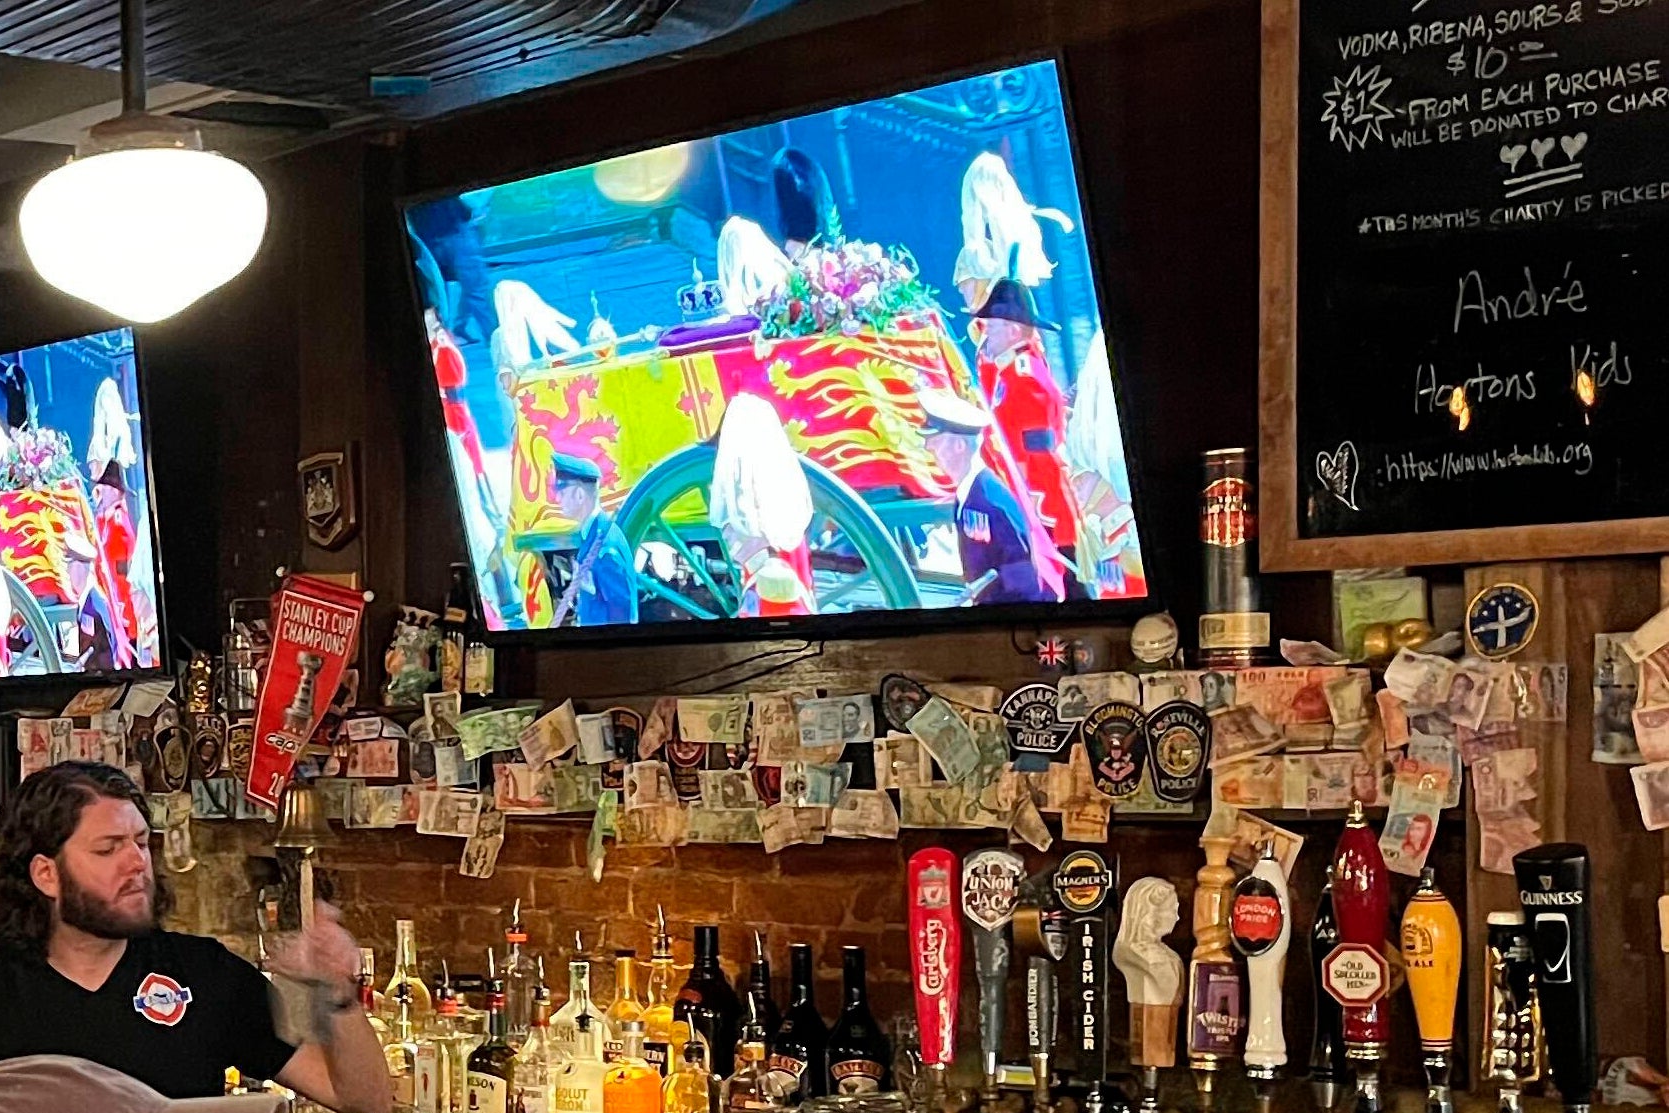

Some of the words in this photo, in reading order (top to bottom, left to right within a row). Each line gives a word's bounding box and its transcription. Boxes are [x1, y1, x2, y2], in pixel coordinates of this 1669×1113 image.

[1338, 30, 1407, 60] VODKA,
[1409, 15, 1492, 48] RIBENA,
[1495, 4, 1563, 33] SOURS
[1565, 2, 1582, 23] &
[1481, 80, 1534, 112] EACH
[1545, 60, 1662, 100] PURCHASE
[1341, 88, 1374, 125] $1
[1390, 129, 1432, 149] WILL
[1439, 123, 1463, 144] BE
[1471, 107, 1561, 138] DONATED
[1567, 100, 1598, 119] TO
[1607, 88, 1669, 113] CHAR
[1575, 194, 1592, 213] IS
[1454, 261, 1587, 333] André
[283, 601, 329, 629] STANLEY
[332, 612, 353, 634] CUP
[282, 621, 347, 657] CHAMPIONS
[1016, 732, 1058, 748] POLICE
[968, 877, 1014, 891] UNION
[971, 890, 1011, 911] JACK
[1520, 890, 1583, 905] GUINNESS
[1234, 904, 1276, 917] LONDON
[919, 919, 950, 996] Carlsberg
[1081, 923, 1094, 984] IRISH
[1082, 990, 1095, 1050] CIDER
